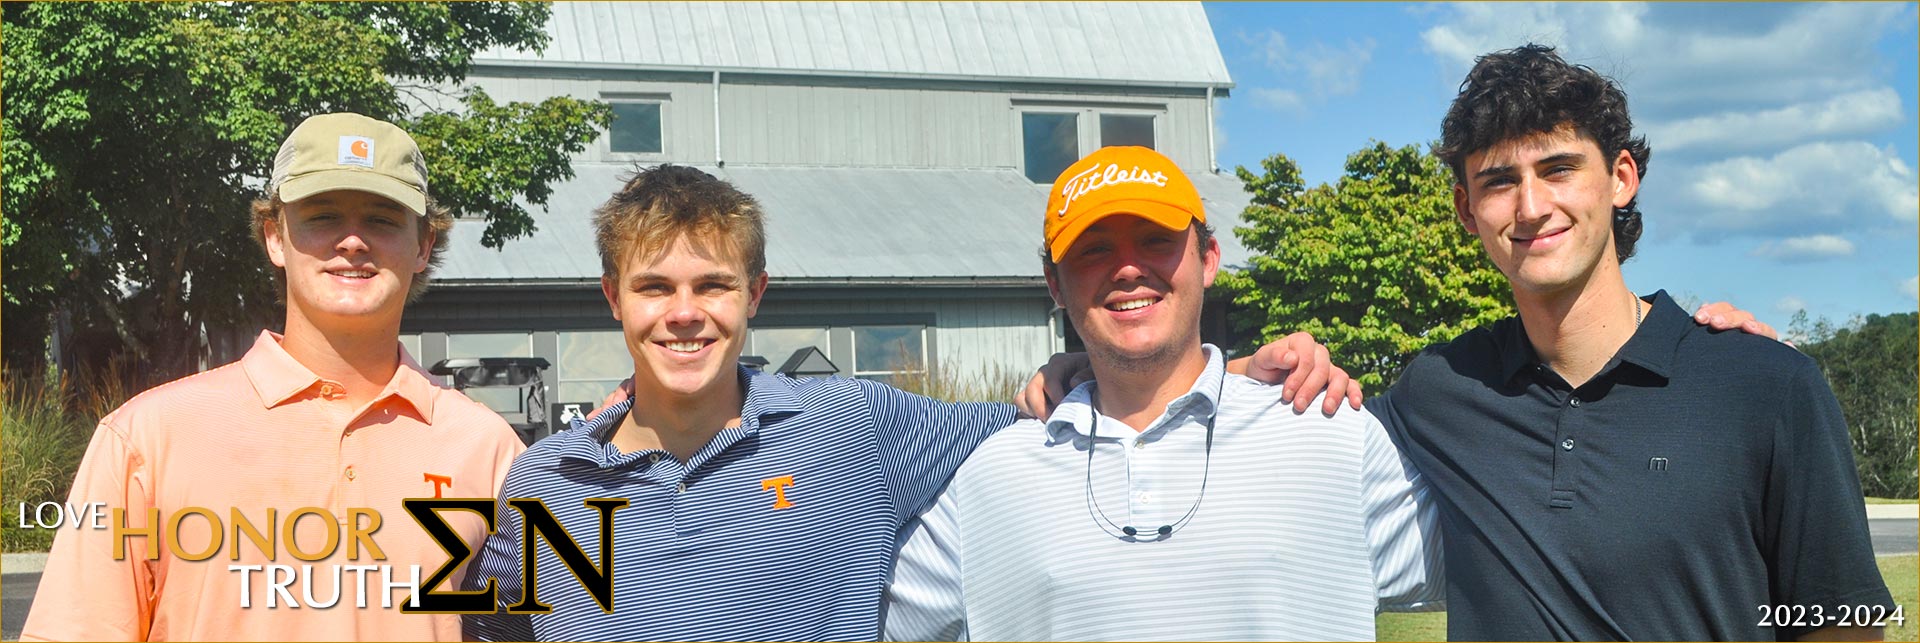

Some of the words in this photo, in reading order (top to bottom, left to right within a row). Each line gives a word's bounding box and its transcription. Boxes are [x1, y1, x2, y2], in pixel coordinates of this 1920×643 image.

[1058, 163, 1168, 216] Titleist
[423, 473, 451, 498] T
[761, 475, 795, 510] T
